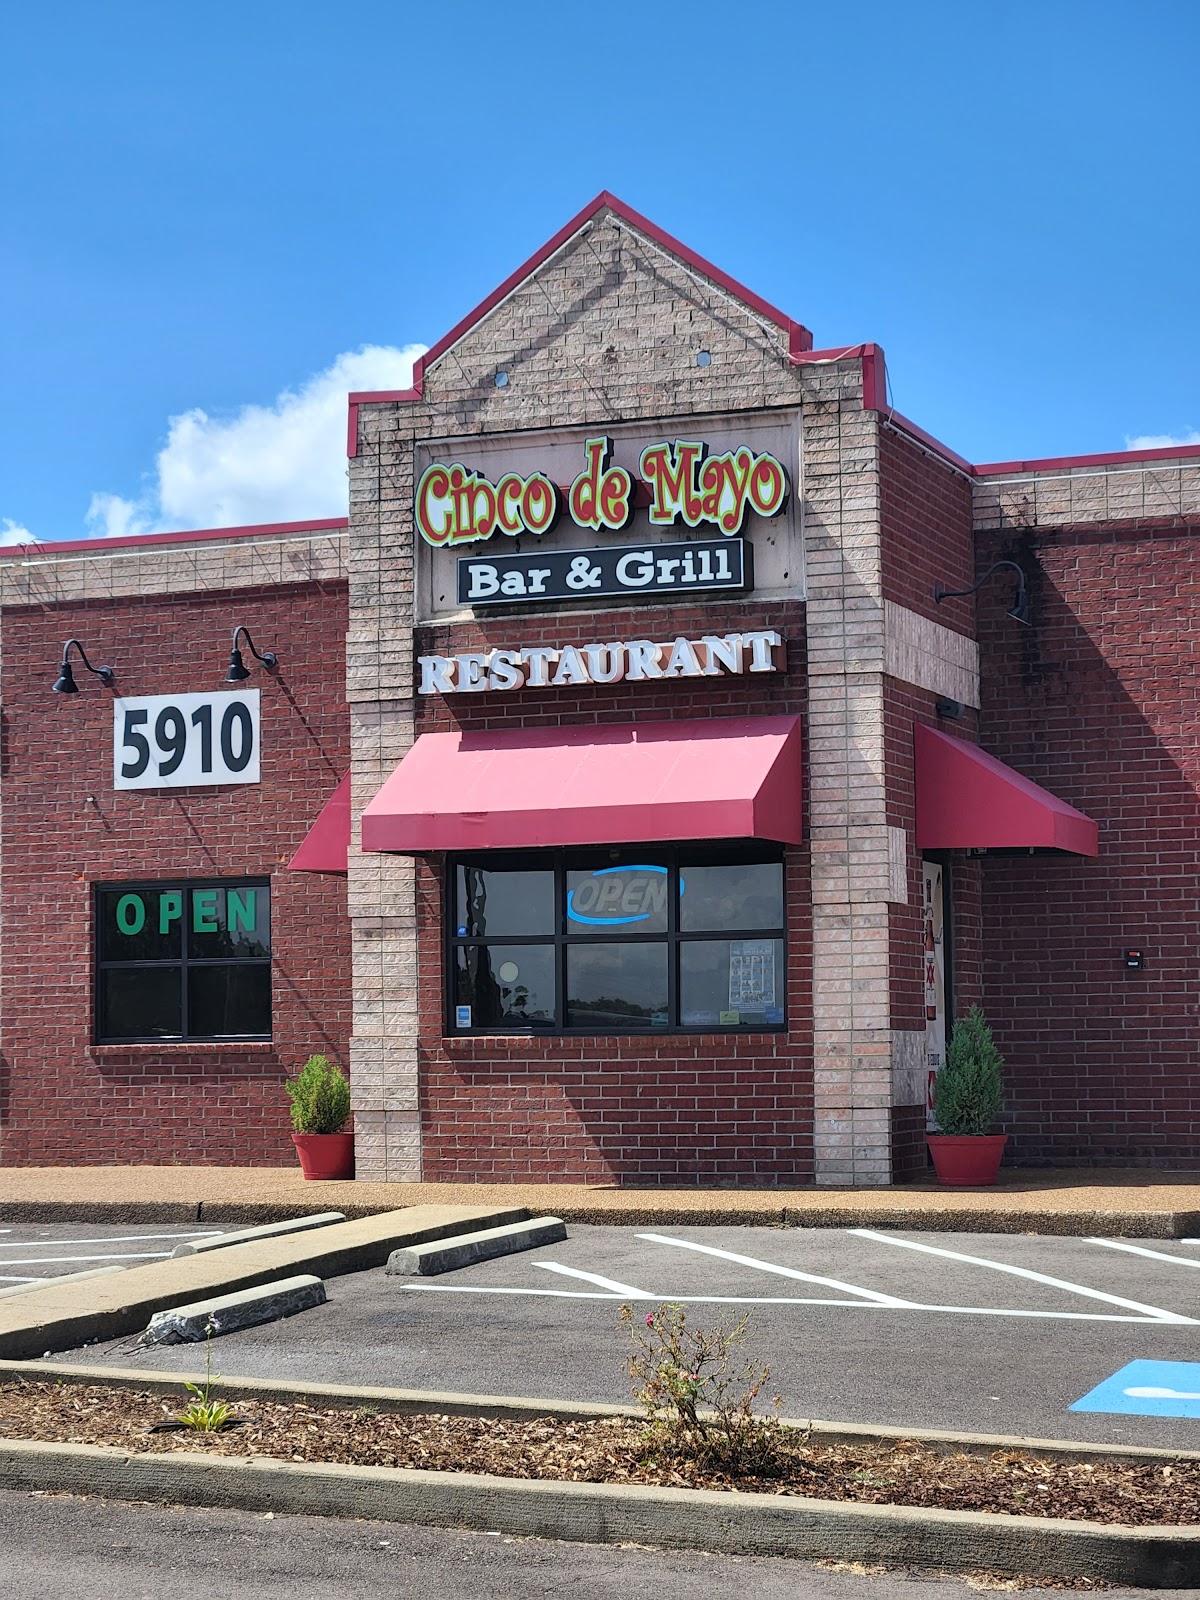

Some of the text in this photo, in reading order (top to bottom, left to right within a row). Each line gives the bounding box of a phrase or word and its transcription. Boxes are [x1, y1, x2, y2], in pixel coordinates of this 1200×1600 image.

[416, 438, 785, 546] Cinco de Mayo
[467, 548, 733, 598] Bar & Grill
[417, 630, 782, 694] RESTAURANT
[121, 701, 254, 779] 5910
[116, 889, 257, 935] OPEN
[572, 878, 668, 912] OPEN
